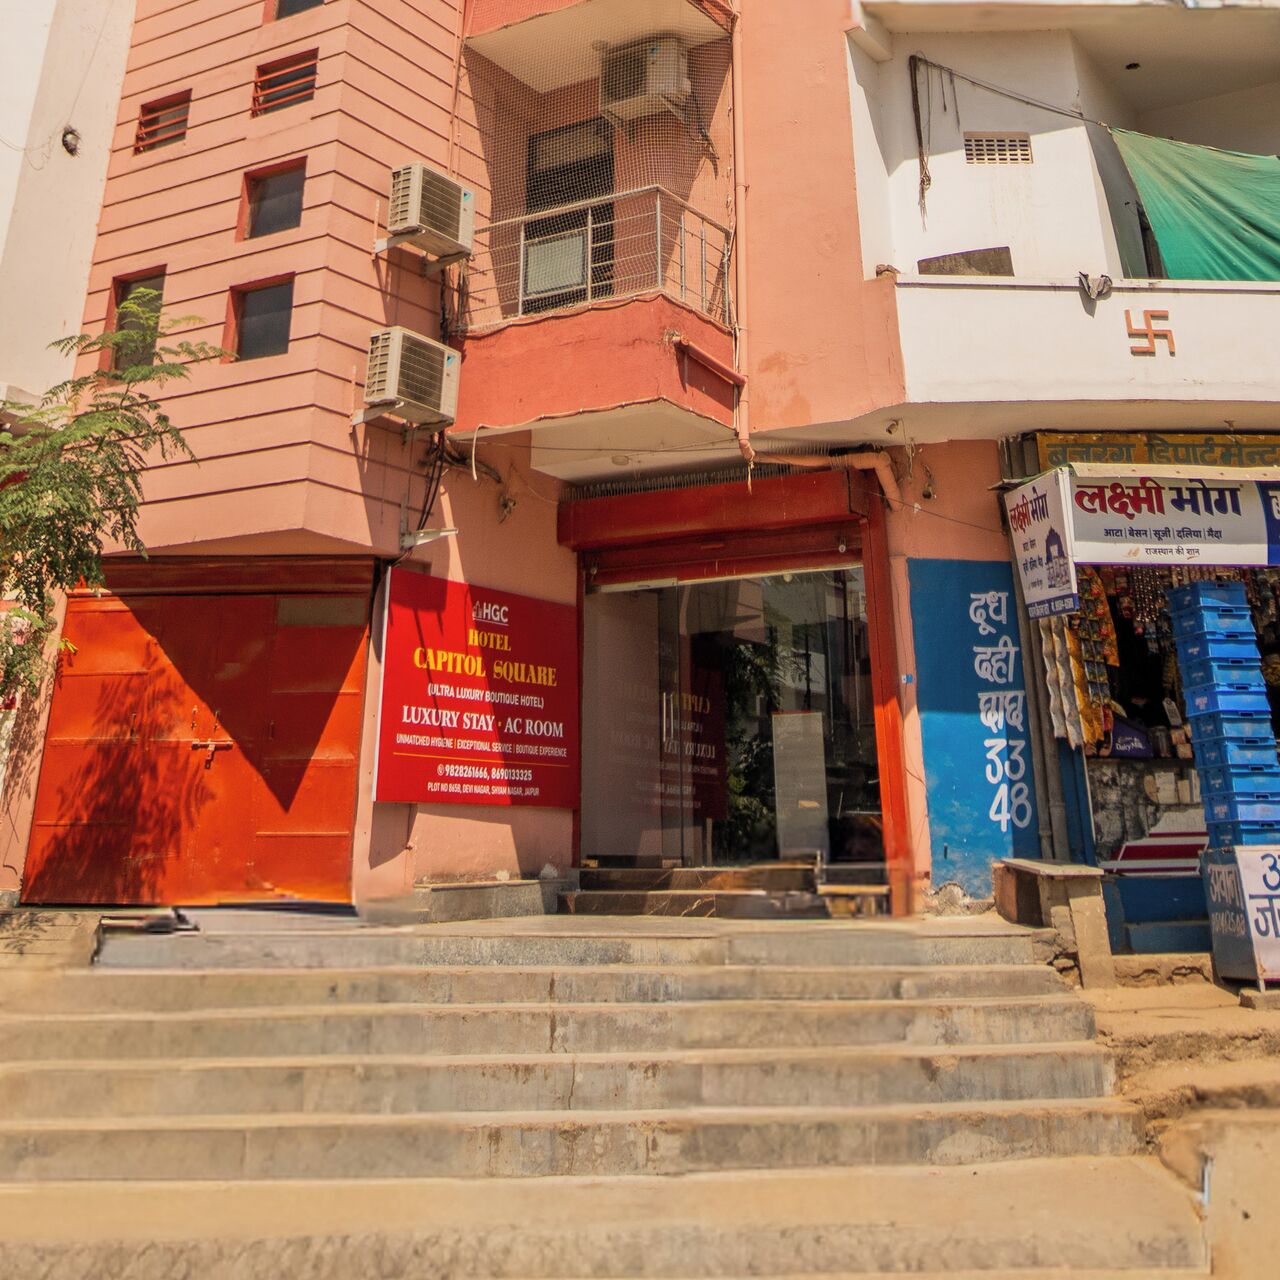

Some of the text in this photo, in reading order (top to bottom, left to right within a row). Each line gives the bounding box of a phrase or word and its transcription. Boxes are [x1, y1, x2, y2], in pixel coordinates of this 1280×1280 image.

[1074, 477, 1166, 520] लक्ष्मी
[1104, 527, 1123, 538] आटा
[1128, 526, 1148, 539] बेसन
[1176, 526, 1202, 539] दलिया
[483, 602, 509, 623] HGC
[969, 590, 1009, 636] दूध
[468, 629, 511, 651] HOTEL
[414, 648, 557, 687] CAPITOL SQUARE
[973, 635, 1020, 684] दही
[428, 683, 544, 709] (ULTRA LUXURY BOUTIQUE HOTEL)
[402, 706, 563, 738] LUXURY STAY AC ROOM
[396, 733, 567, 758] UNMATCHED HYGIENE EXCEPTIONAL SERVICE BOUTIQUE EXPERIENCE
[427, 782, 440, 792] PLOT
[989, 782, 1032, 833] 48
